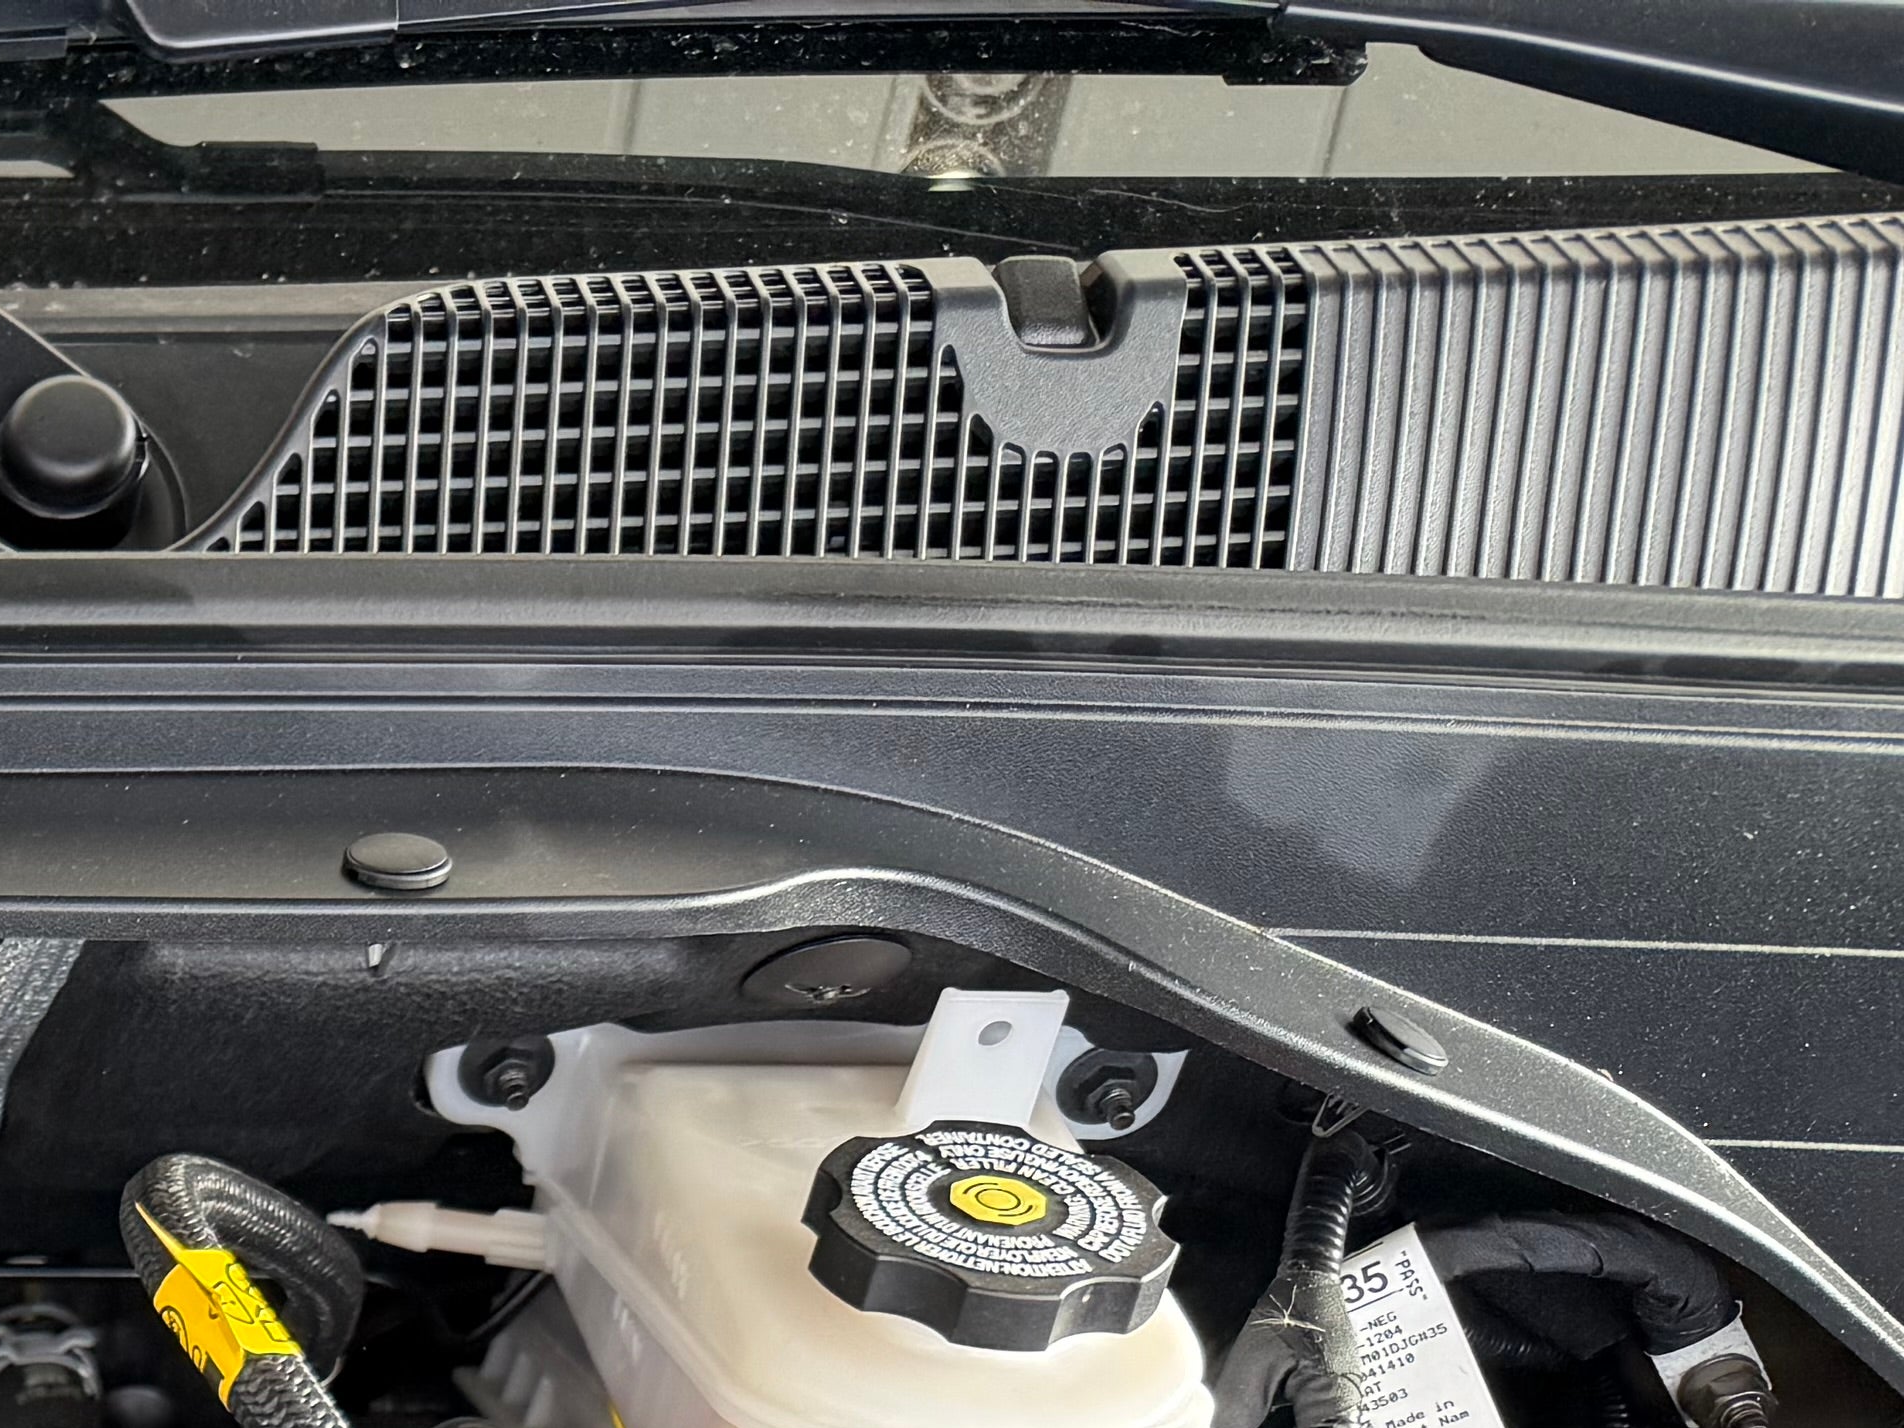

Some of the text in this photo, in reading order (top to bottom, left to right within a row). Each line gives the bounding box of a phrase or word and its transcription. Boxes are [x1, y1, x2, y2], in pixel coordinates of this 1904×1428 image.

[930, 1144, 987, 1159] ONLY
[985, 1145, 1026, 1162] USE
[1028, 1141, 1106, 1176] SEALED
[945, 1156, 1019, 1174] FILLER
[1015, 1163, 1080, 1195] CLEAN
[1097, 1178, 1145, 1209] FROM
[1085, 1194, 1122, 1235] BEFORE
[950, 1225, 1059, 1249] PROVENANT
[1072, 1228, 1115, 1253] CAP
[1340, 1261, 1390, 1304] 35
[1434, 1399, 1455, 1412] in
[1438, 1408, 1470, 1427] Nam
